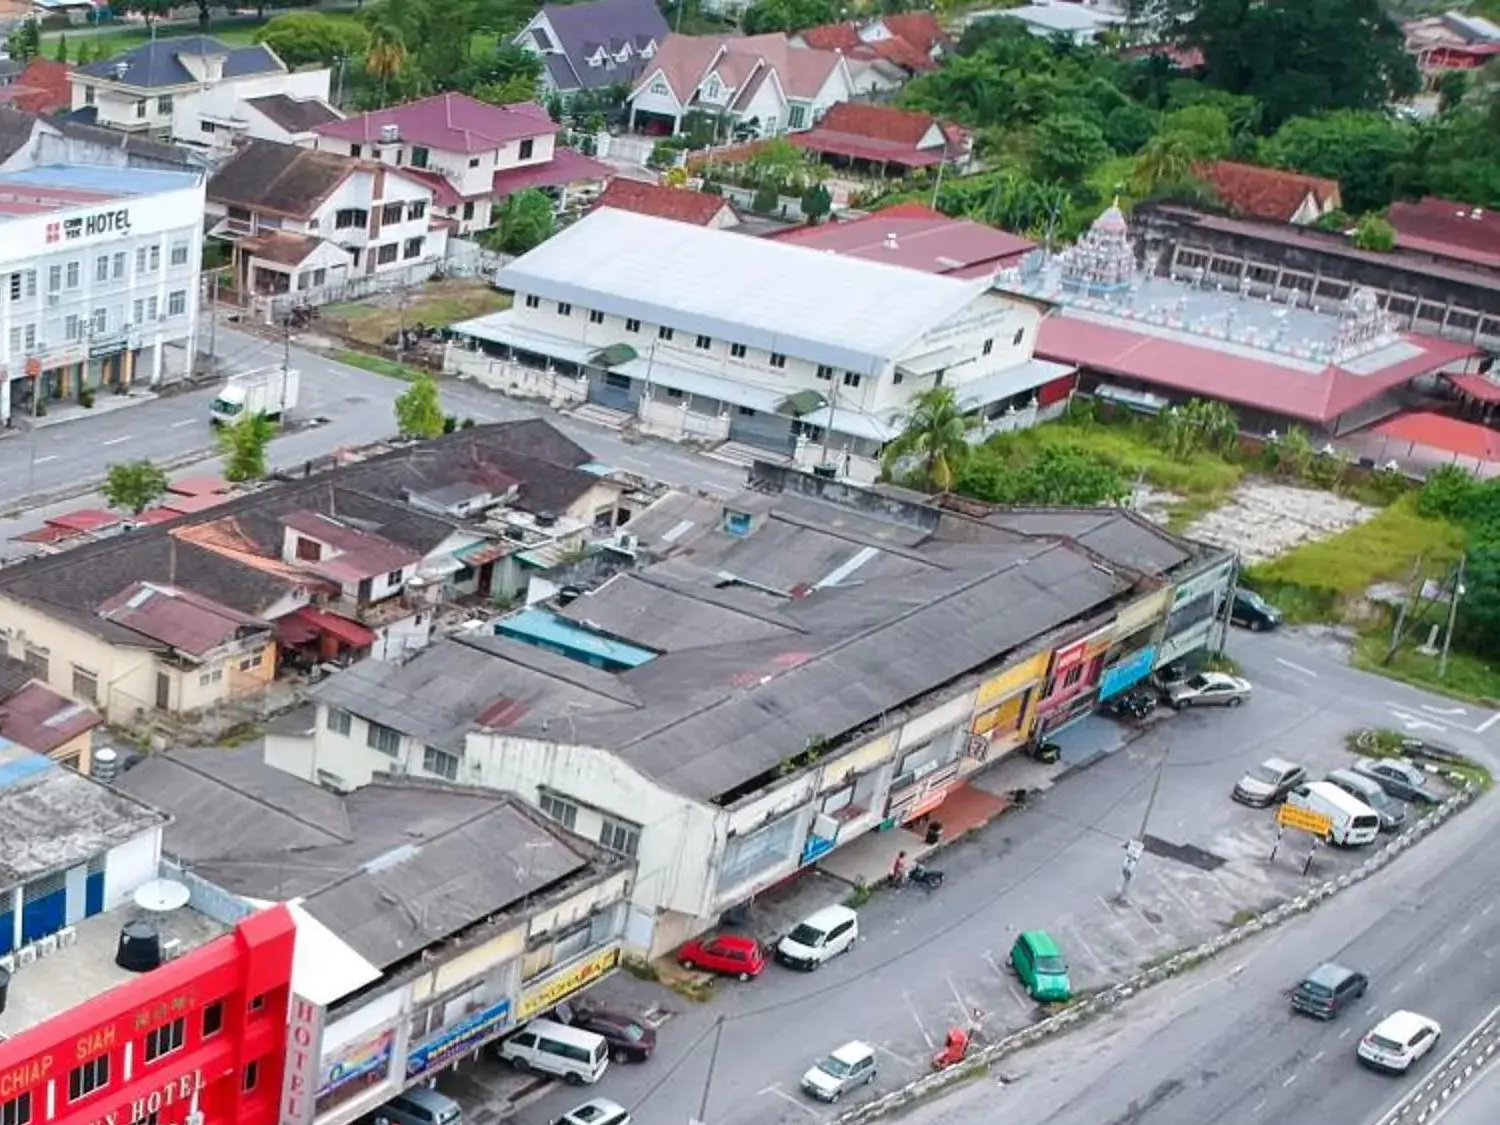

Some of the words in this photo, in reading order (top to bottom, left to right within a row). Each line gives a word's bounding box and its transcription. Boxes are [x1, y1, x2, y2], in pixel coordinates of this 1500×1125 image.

[85, 208, 132, 237] HOTEL
[0, 1056, 53, 1095] CHIAP
[76, 1025, 116, 1060] SIAH
[289, 1001, 314, 1118] HOTEL
[130, 1069, 207, 1121] HOTEL
